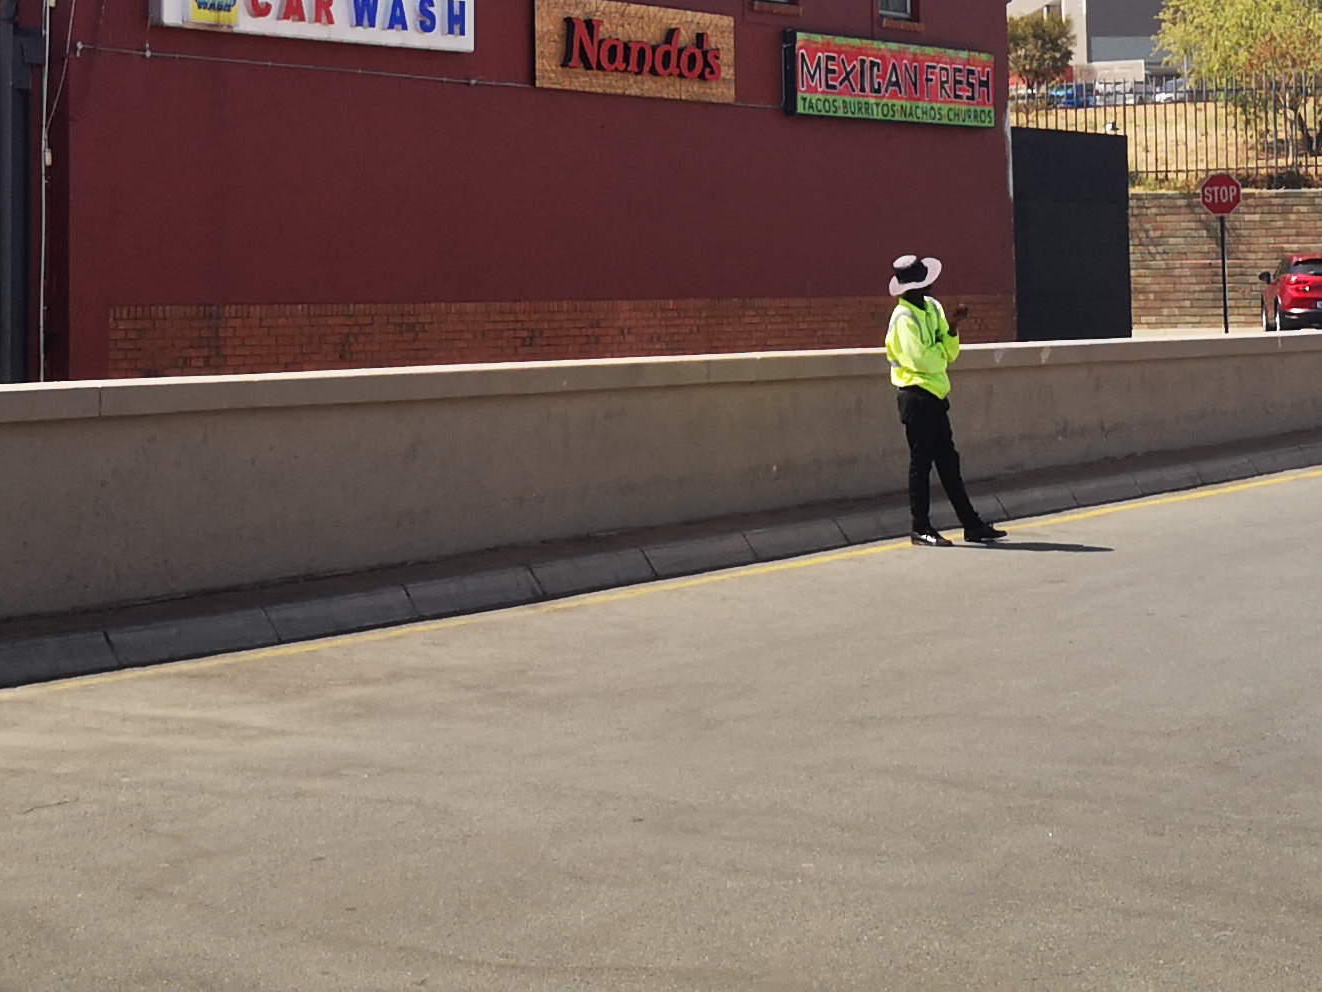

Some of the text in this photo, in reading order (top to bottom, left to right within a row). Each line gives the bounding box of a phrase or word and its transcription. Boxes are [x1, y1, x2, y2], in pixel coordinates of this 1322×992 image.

[561, 17, 722, 81] Nando's
[798, 49, 992, 104] MEXICAN FRESH
[801, 96, 993, 124] TACOS BURRITOS NACHOS CHURROS
[1204, 185, 1237, 203] STOP
